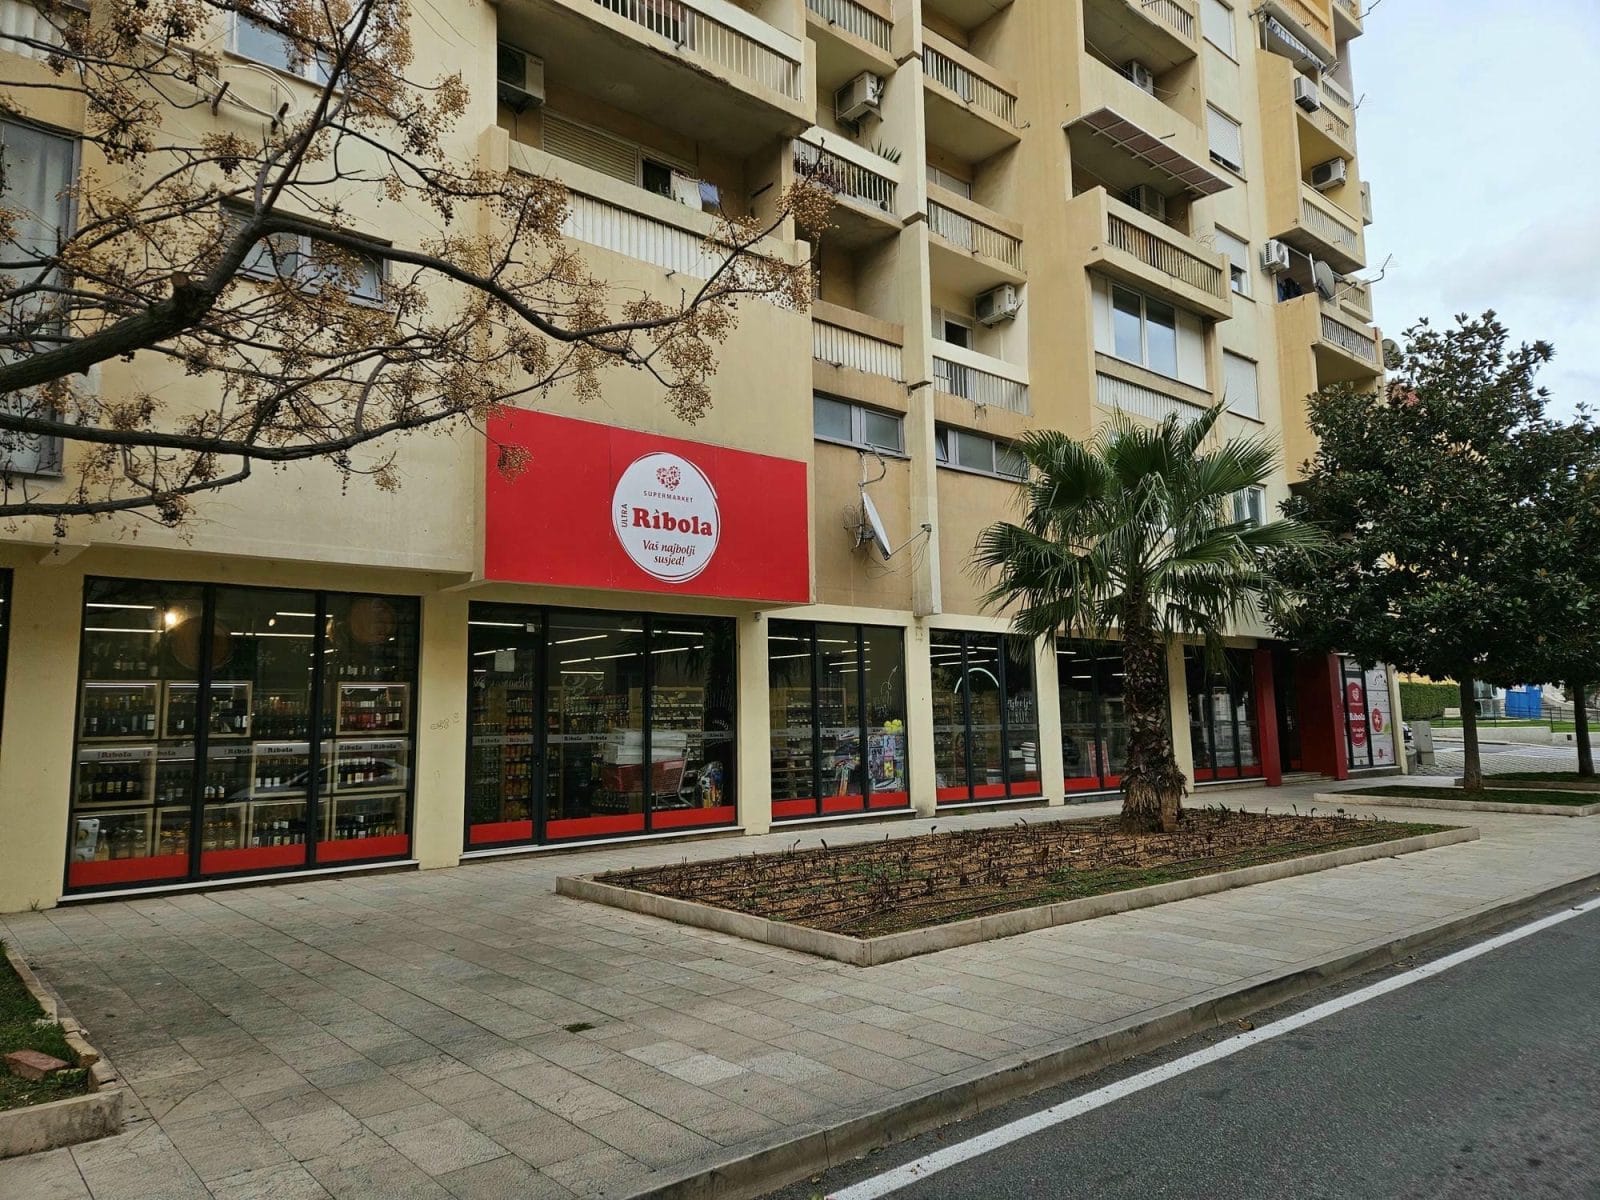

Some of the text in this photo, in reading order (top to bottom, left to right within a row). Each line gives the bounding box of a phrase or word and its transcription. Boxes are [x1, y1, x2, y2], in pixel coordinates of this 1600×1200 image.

[643, 490, 694, 503] SUPERMARKET
[631, 507, 713, 536] Ribola
[642, 539, 696, 555] Vaš najbolji
[653, 554, 685, 566] susjed!
